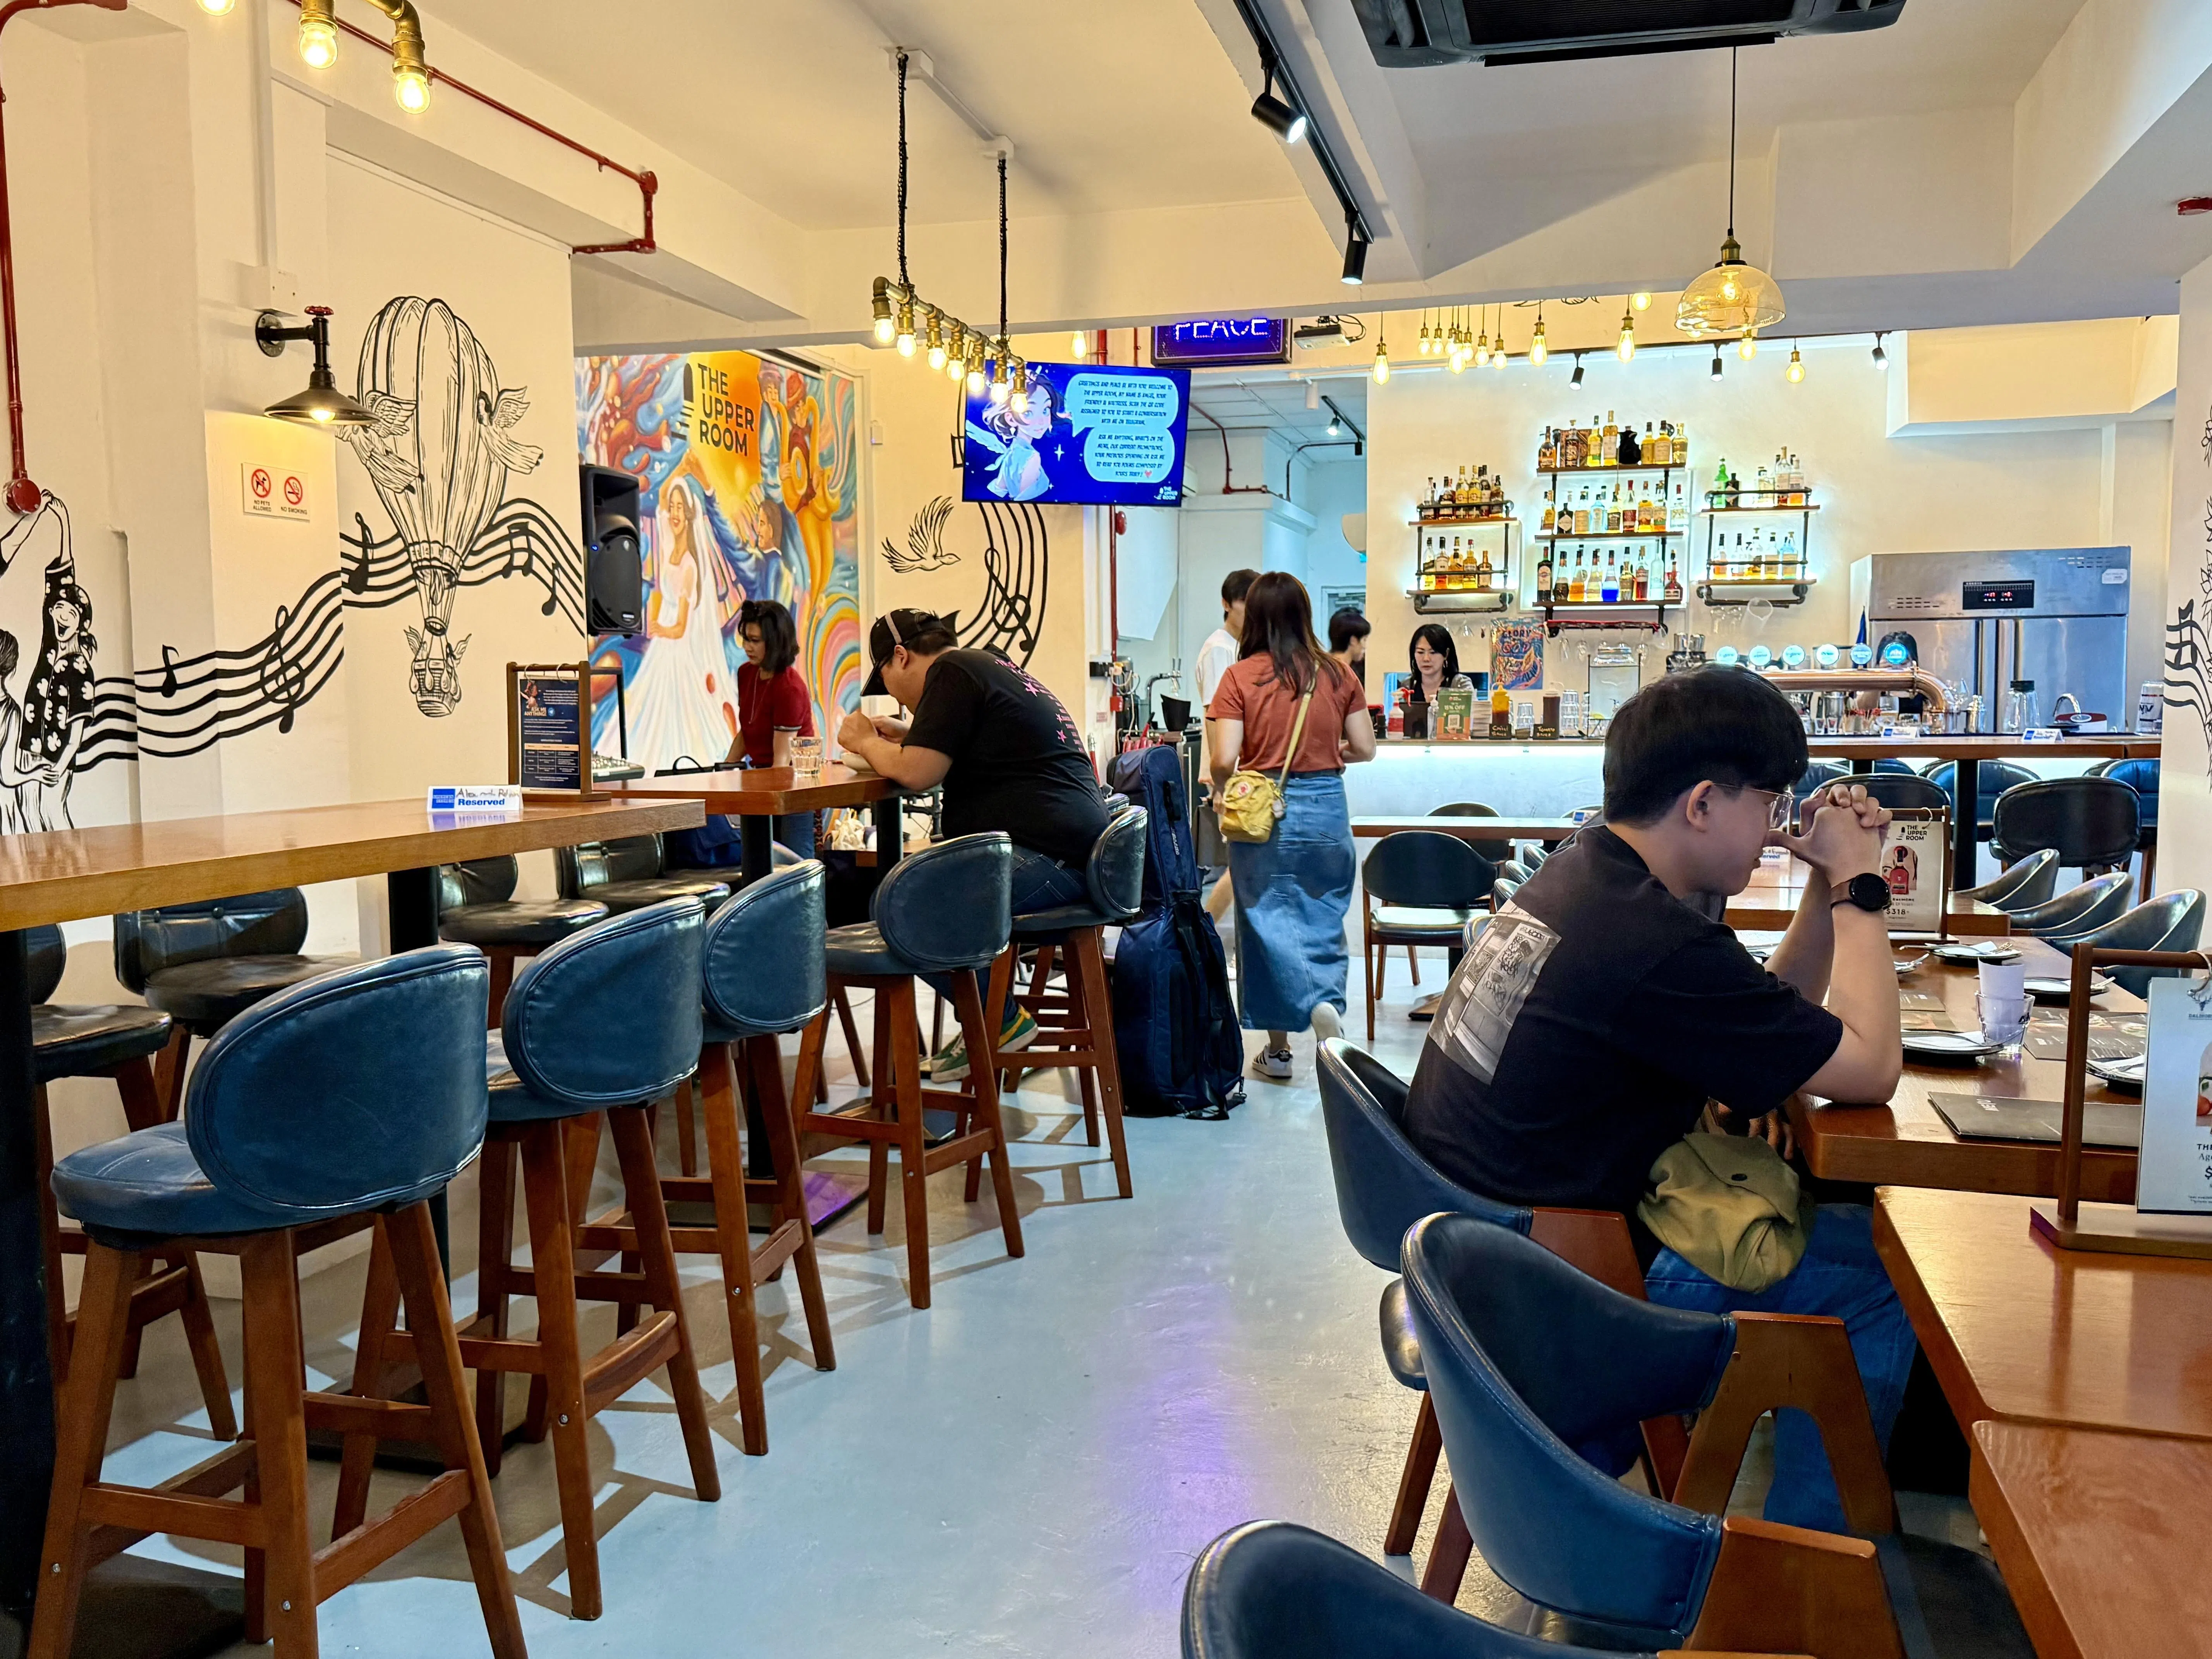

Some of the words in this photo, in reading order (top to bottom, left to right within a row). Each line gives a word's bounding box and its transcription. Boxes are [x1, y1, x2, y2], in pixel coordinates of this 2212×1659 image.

[698, 363, 728, 397] THE
[702, 393, 754, 431] UPPER
[700, 419, 747, 456] ROOM
